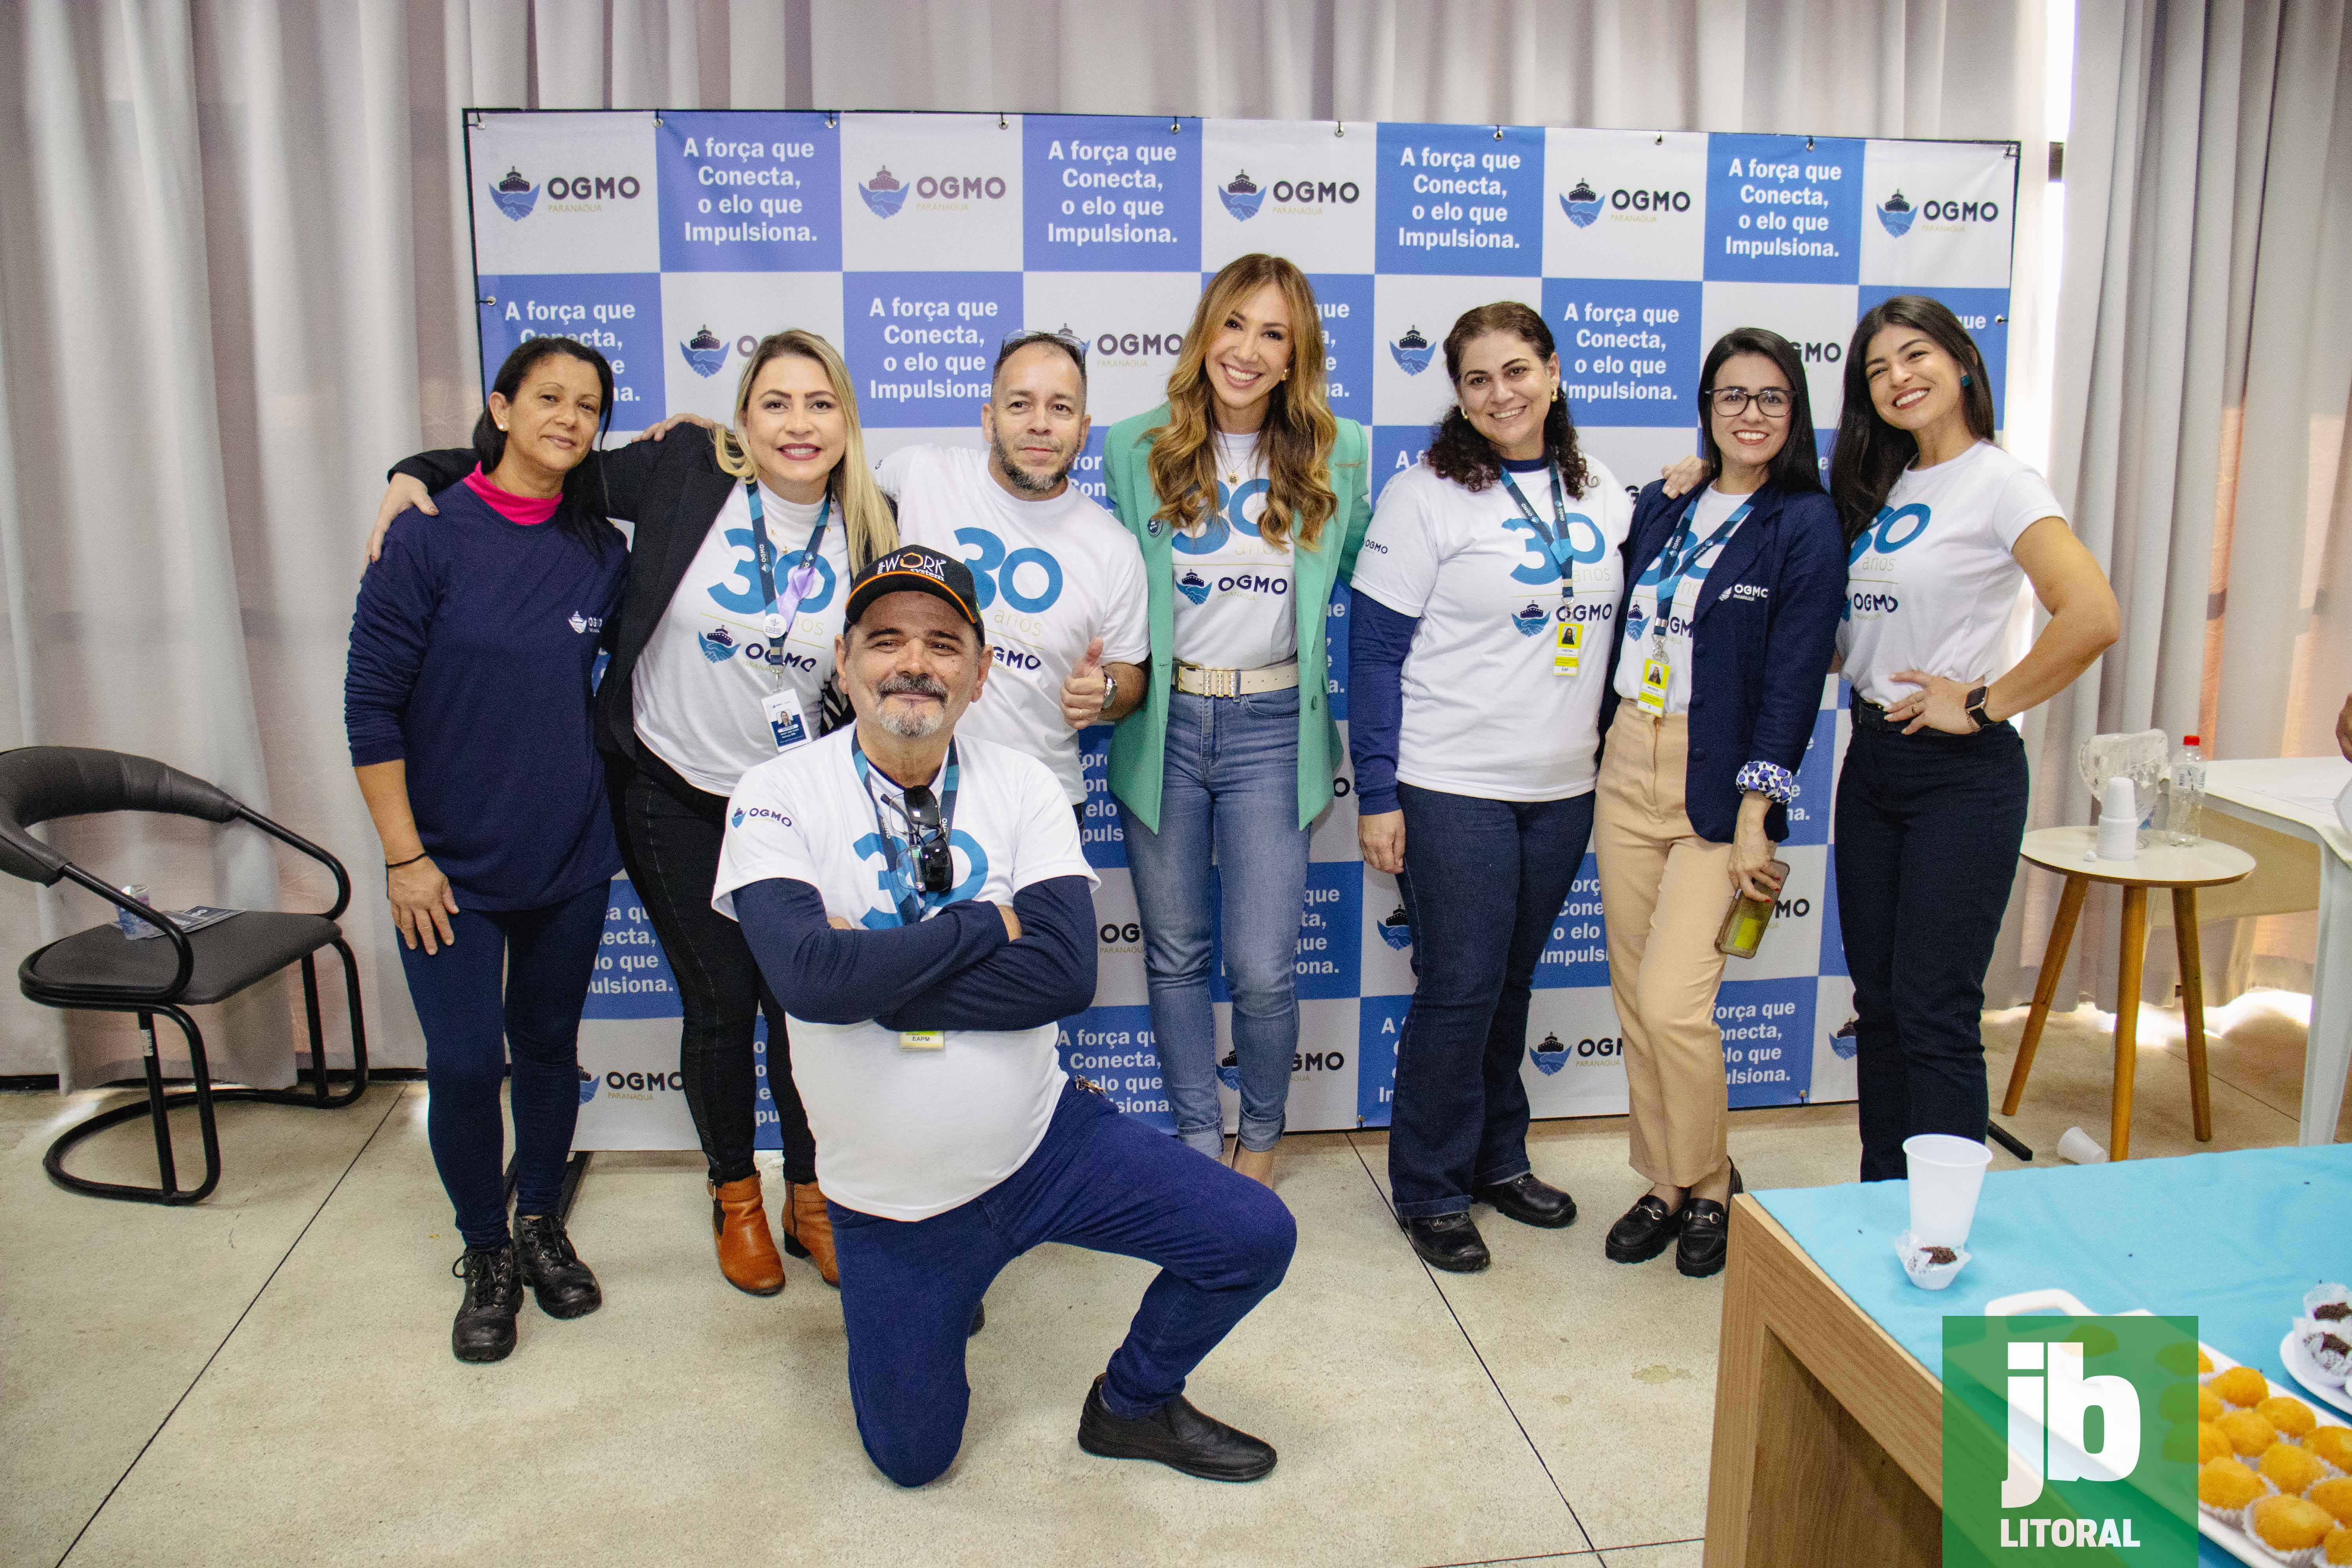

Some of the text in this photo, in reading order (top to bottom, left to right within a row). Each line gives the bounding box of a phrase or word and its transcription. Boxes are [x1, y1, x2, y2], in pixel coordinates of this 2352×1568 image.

[684, 137, 814, 162] A força que
[1049, 140, 1176, 164] A força que
[1401, 148, 1520, 172] A força que
[698, 166, 800, 189] Conecta,
[1063, 169, 1163, 191] Conecta,
[1729, 158, 1842, 183] A força que
[548, 176, 640, 200] OGMO
[916, 176, 1006, 199] OGMO
[1273, 181, 1359, 203] OGMO
[1413, 175, 1506, 199] Conecta,
[1740, 185, 1828, 209] Conecta,
[698, 195, 802, 218] o elo que
[1062, 197, 1164, 219] o elo que
[1611, 189, 1690, 212] OGMO
[1923, 201, 1998, 222] OGMO
[1412, 202, 1507, 225] o elo que
[1739, 211, 1828, 234] o elo que
[685, 222, 817, 245] Impulsiona.
[1048, 223, 1177, 246] Impulsiona.
[1399, 227, 1520, 250] Impulsiona.
[1726, 236, 1839, 260] Impulsiona.
[505, 301, 635, 325] A força que
[870, 298, 998, 321] A força que
[1564, 303, 1679, 327] A força que
[884, 325, 984, 348] Conecta,
[1097, 334, 1182, 355] OGMO
[1576, 330, 1666, 352] Conecta,
[884, 353, 985, 374] o elo que
[1575, 356, 1666, 378] o elo que
[1562, 382, 1677, 402] Impulsiona.
[1396, 451, 1410, 468] A
[1365, 539, 1388, 554] OGMO
[1501, 512, 1606, 585] 30
[708, 528, 836, 614] 30
[910, 568, 945, 582] system
[1862, 557, 1896, 571] anos
[1218, 575, 1287, 595] OGMO
[1556, 603, 1612, 622] OGMO
[1853, 593, 1898, 613] OGMO
[995, 609, 1042, 636] anos
[993, 646, 1041, 670] GMO
[749, 808, 792, 828] OGMO
[1085, 800, 1117, 817] elo
[1304, 889, 1340, 907] que
[1553, 922, 1601, 940] o elo
[619, 954, 659, 973] que
[1762, 1002, 1796, 1020] que
[1381, 1017, 1395, 1033] A
[1056, 1029, 1072, 1047] A
[1077, 1029, 1130, 1049] força
[1069, 1051, 1161, 1070] Conecta,
[1748, 1047, 1782, 1065] que
[1125, 1076, 1163, 1094] que
